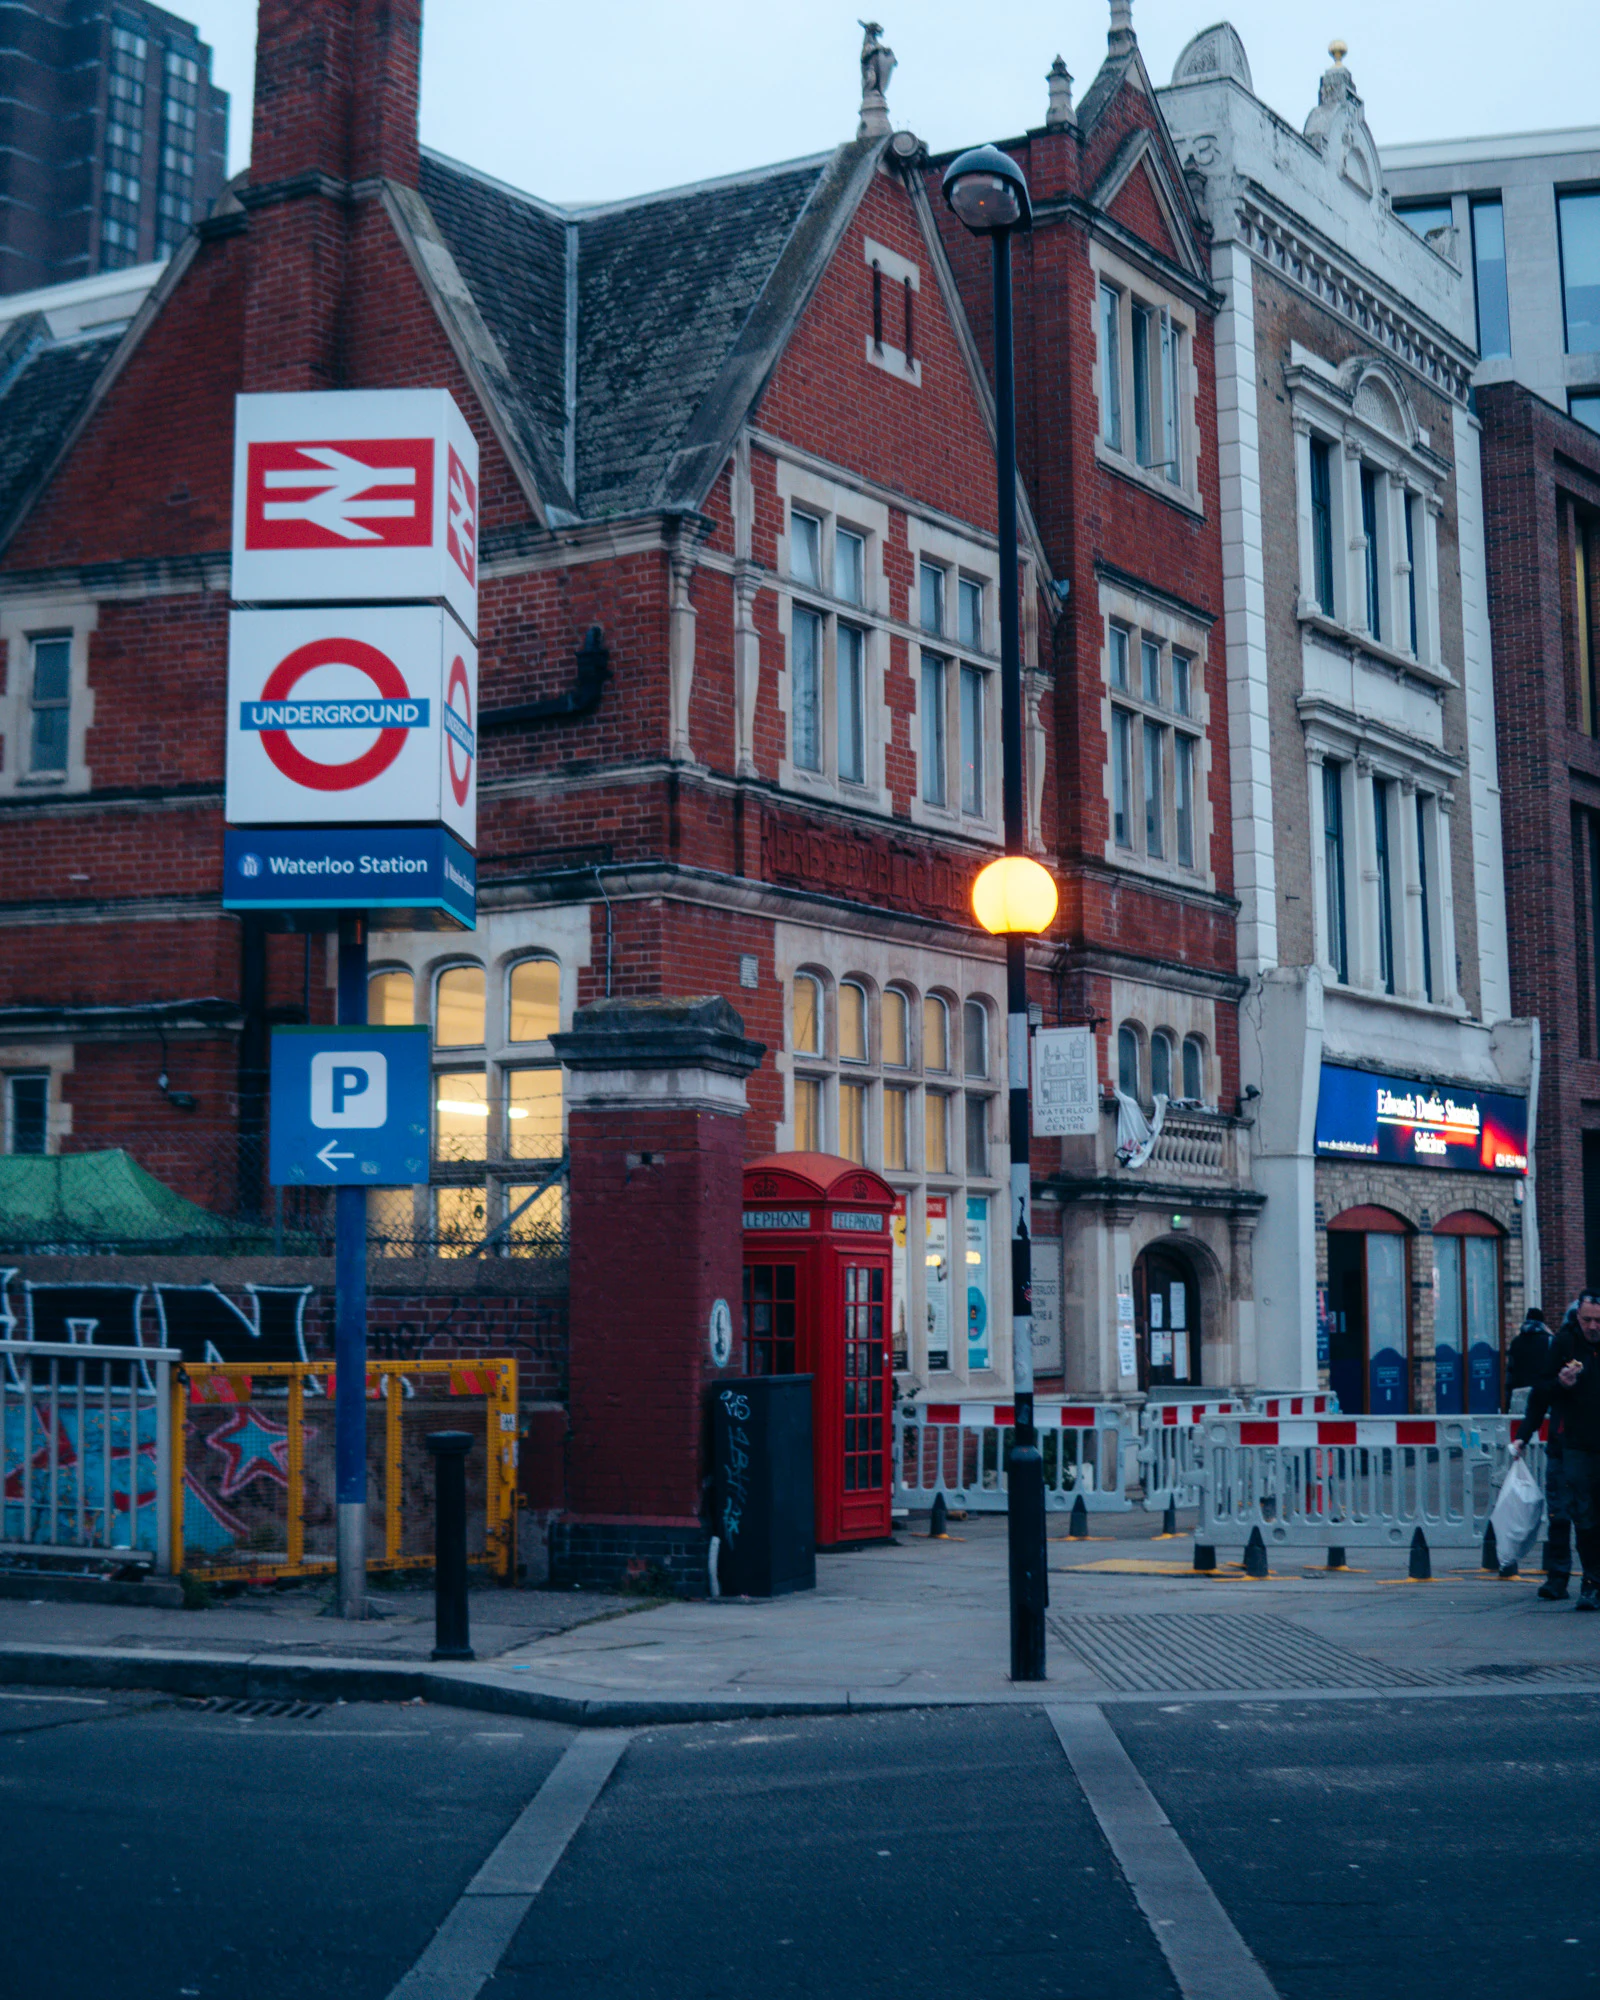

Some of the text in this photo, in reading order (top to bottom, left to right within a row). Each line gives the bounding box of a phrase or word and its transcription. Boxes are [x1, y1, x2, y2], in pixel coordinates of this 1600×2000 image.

[252, 703, 419, 725] UNDERGROUND
[269, 855, 428, 875] Waterloo Station
[332, 1066, 369, 1114] P
[1037, 1106, 1093, 1116] WATERLOO
[1047, 1115, 1085, 1123] ACTION
[1044, 1123, 1086, 1132] CENTRE
[744, 1212, 809, 1227] LEPHONE
[834, 1213, 882, 1230] TELEPHONE
